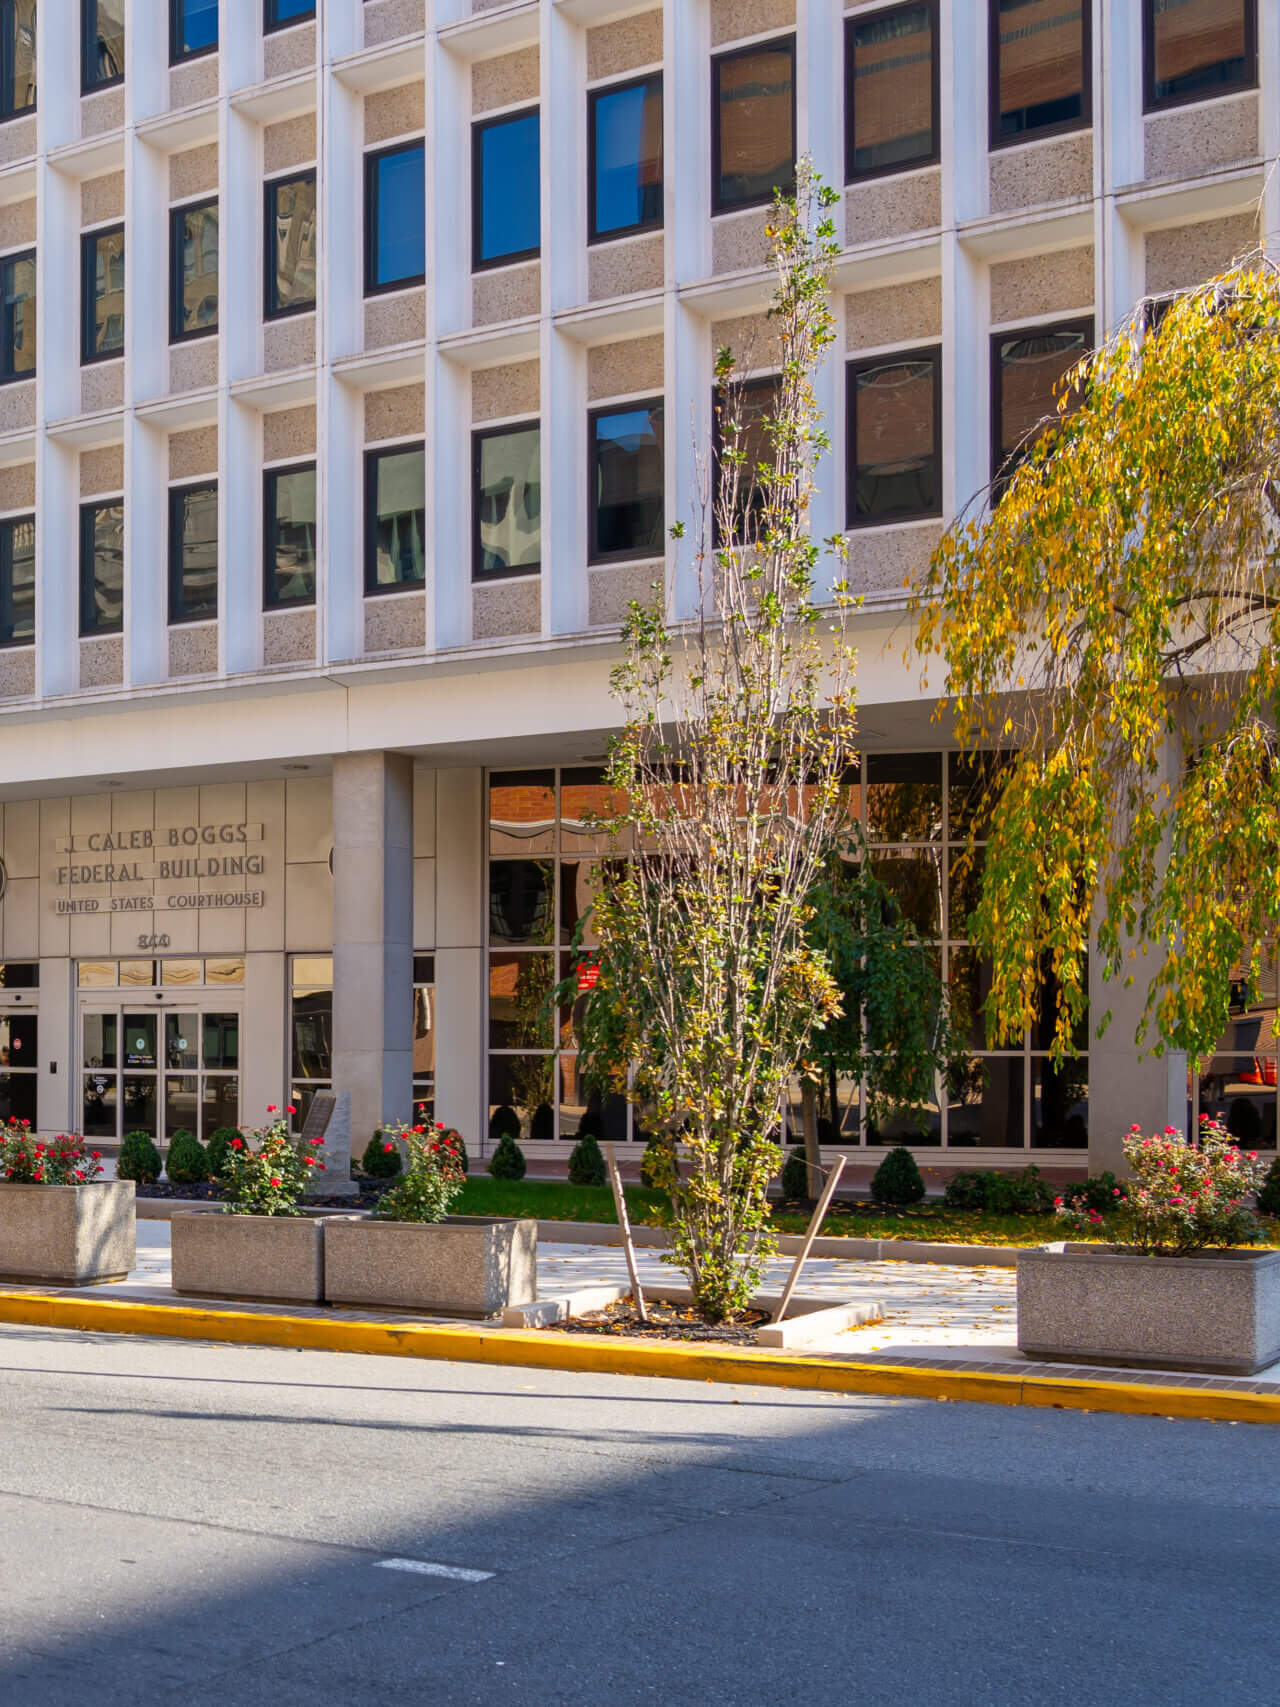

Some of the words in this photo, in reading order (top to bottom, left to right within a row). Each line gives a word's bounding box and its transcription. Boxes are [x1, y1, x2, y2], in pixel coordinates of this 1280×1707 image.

[88, 830, 153, 851] CALEB
[168, 824, 248, 846] BOGGS
[58, 863, 144, 885] FEDERAL
[159, 856, 261, 879] BUILDING
[58, 899, 100, 912] UNITED
[111, 897, 154, 910] STATES
[167, 893, 260, 907] COURTHOUSE
[138, 934, 170, 949] 844
